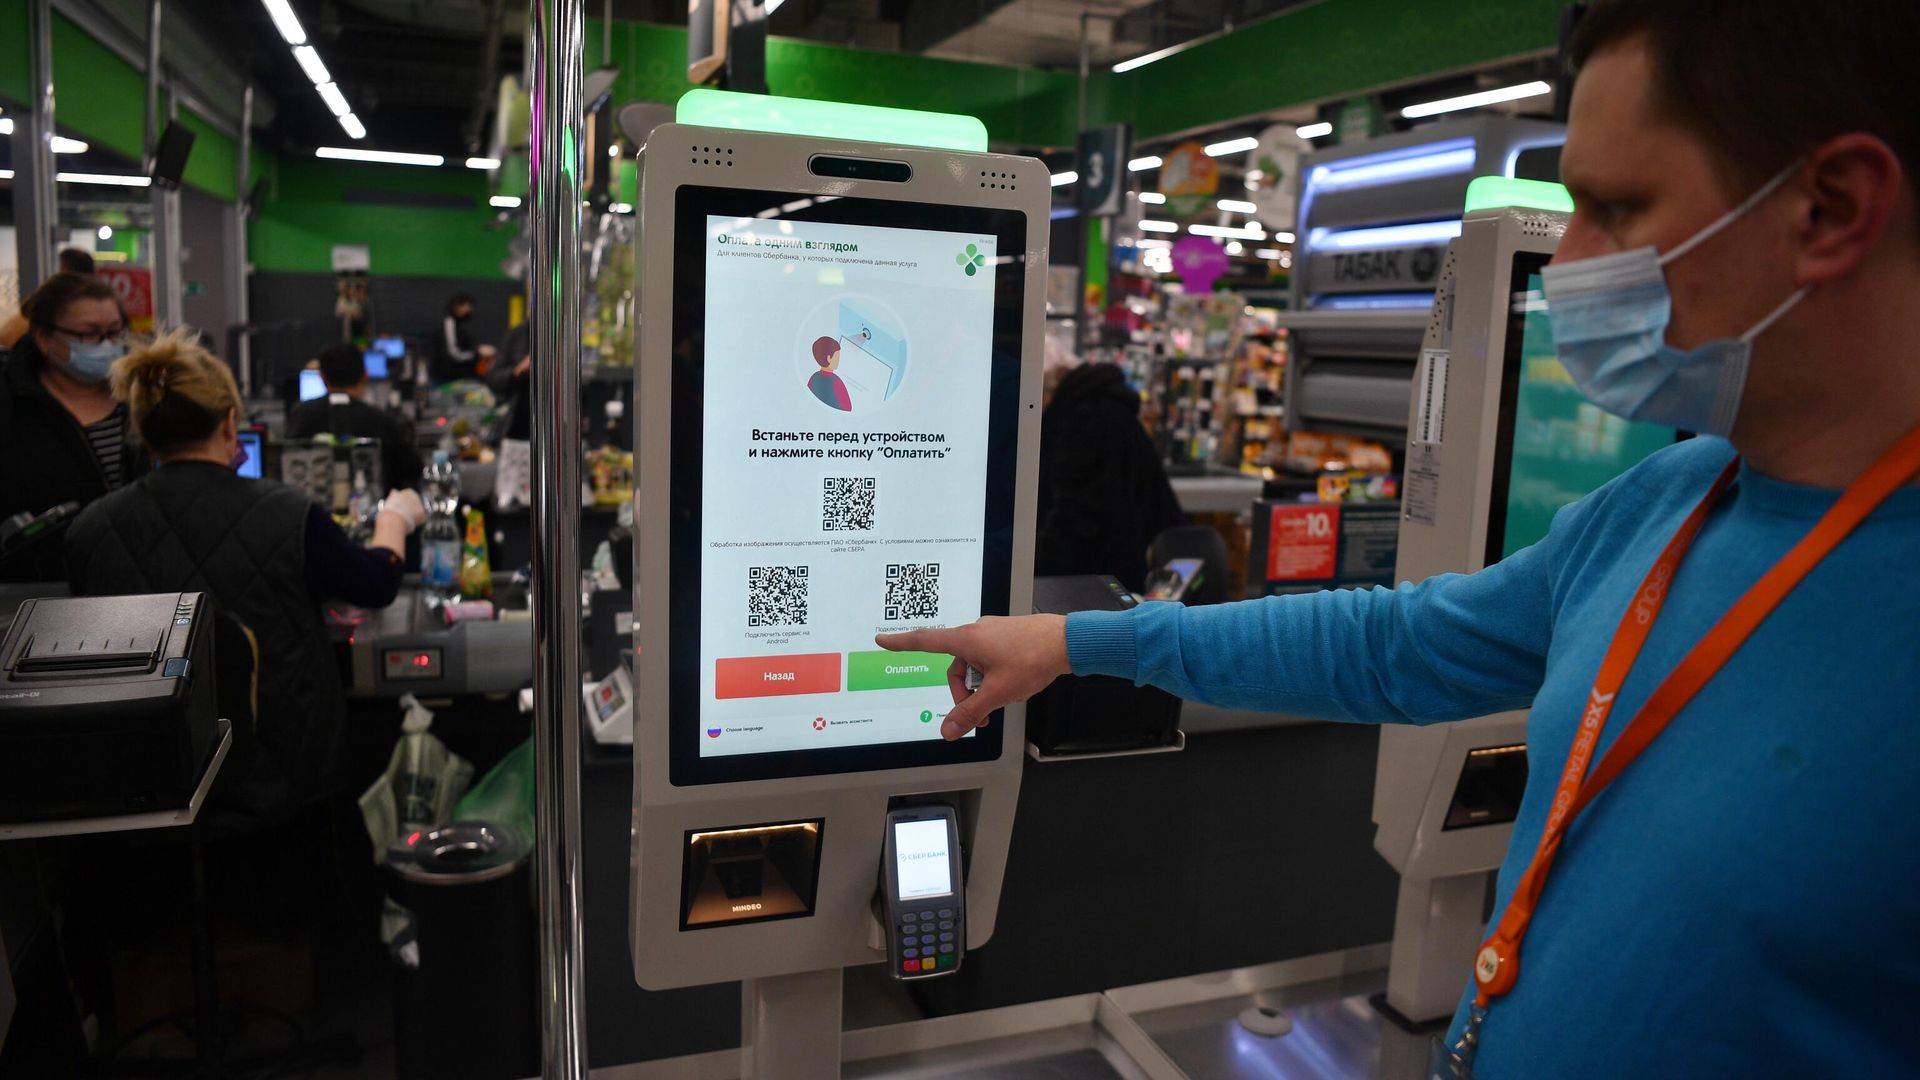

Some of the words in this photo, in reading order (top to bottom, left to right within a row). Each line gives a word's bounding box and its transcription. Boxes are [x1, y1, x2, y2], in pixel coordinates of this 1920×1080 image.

[1087, 152, 1104, 188] 3
[717, 233, 761, 247] Оплаа
[764, 237, 802, 249] одним
[805, 241, 859, 253] взглядом
[717, 249, 730, 257] Для
[731, 251, 761, 259] клиентов
[762, 252, 801, 262] Сбербанка,
[807, 256, 834, 264] которых
[835, 257, 874, 265] подключена
[898, 260, 918, 268] услуга
[1333, 250, 1402, 280] ТАБАК
[751, 428, 815, 442] Встаньте
[818, 431, 859, 444] перед
[862, 430, 945, 444] устройством
[748, 448, 757, 458] и
[761, 447, 824, 458] нажмите
[827, 448, 874, 461] кнопку
[1305, 511, 1330, 538] 10
[743, 540, 783, 548] изображения
[784, 539, 830, 547] осуществляется
[745, 630, 781, 639] Подключить
[782, 630, 801, 638] сервис
[763, 671, 795, 681] Назад
[884, 664, 930, 675] Оплатить
[1583, 702, 1605, 729] X5
[1562, 730, 1594, 785] RETAIL
[732, 903, 762, 912] MINDEO
